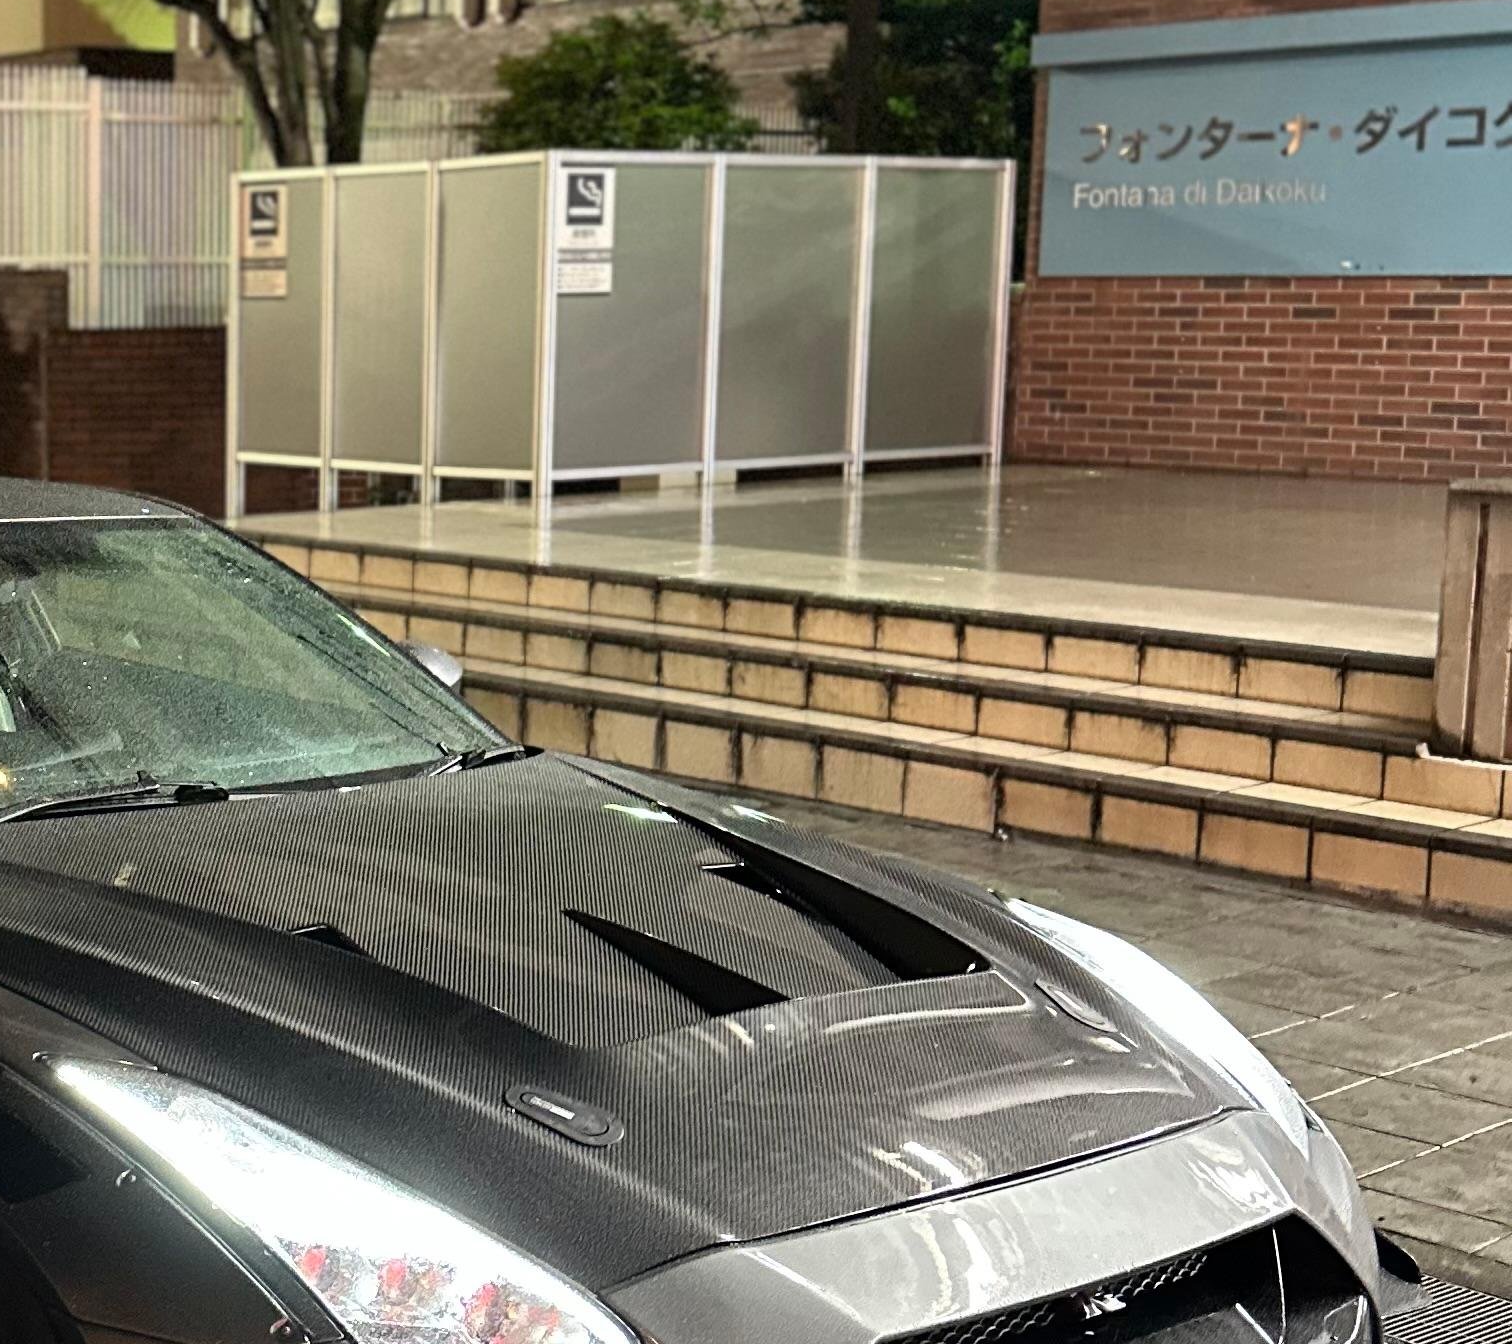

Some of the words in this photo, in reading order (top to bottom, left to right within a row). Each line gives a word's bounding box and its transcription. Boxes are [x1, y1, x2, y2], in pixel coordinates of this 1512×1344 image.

[1072, 182, 1175, 209] Fontana
[1184, 179, 1207, 205] di
[1216, 177, 1327, 205] Daikoku
